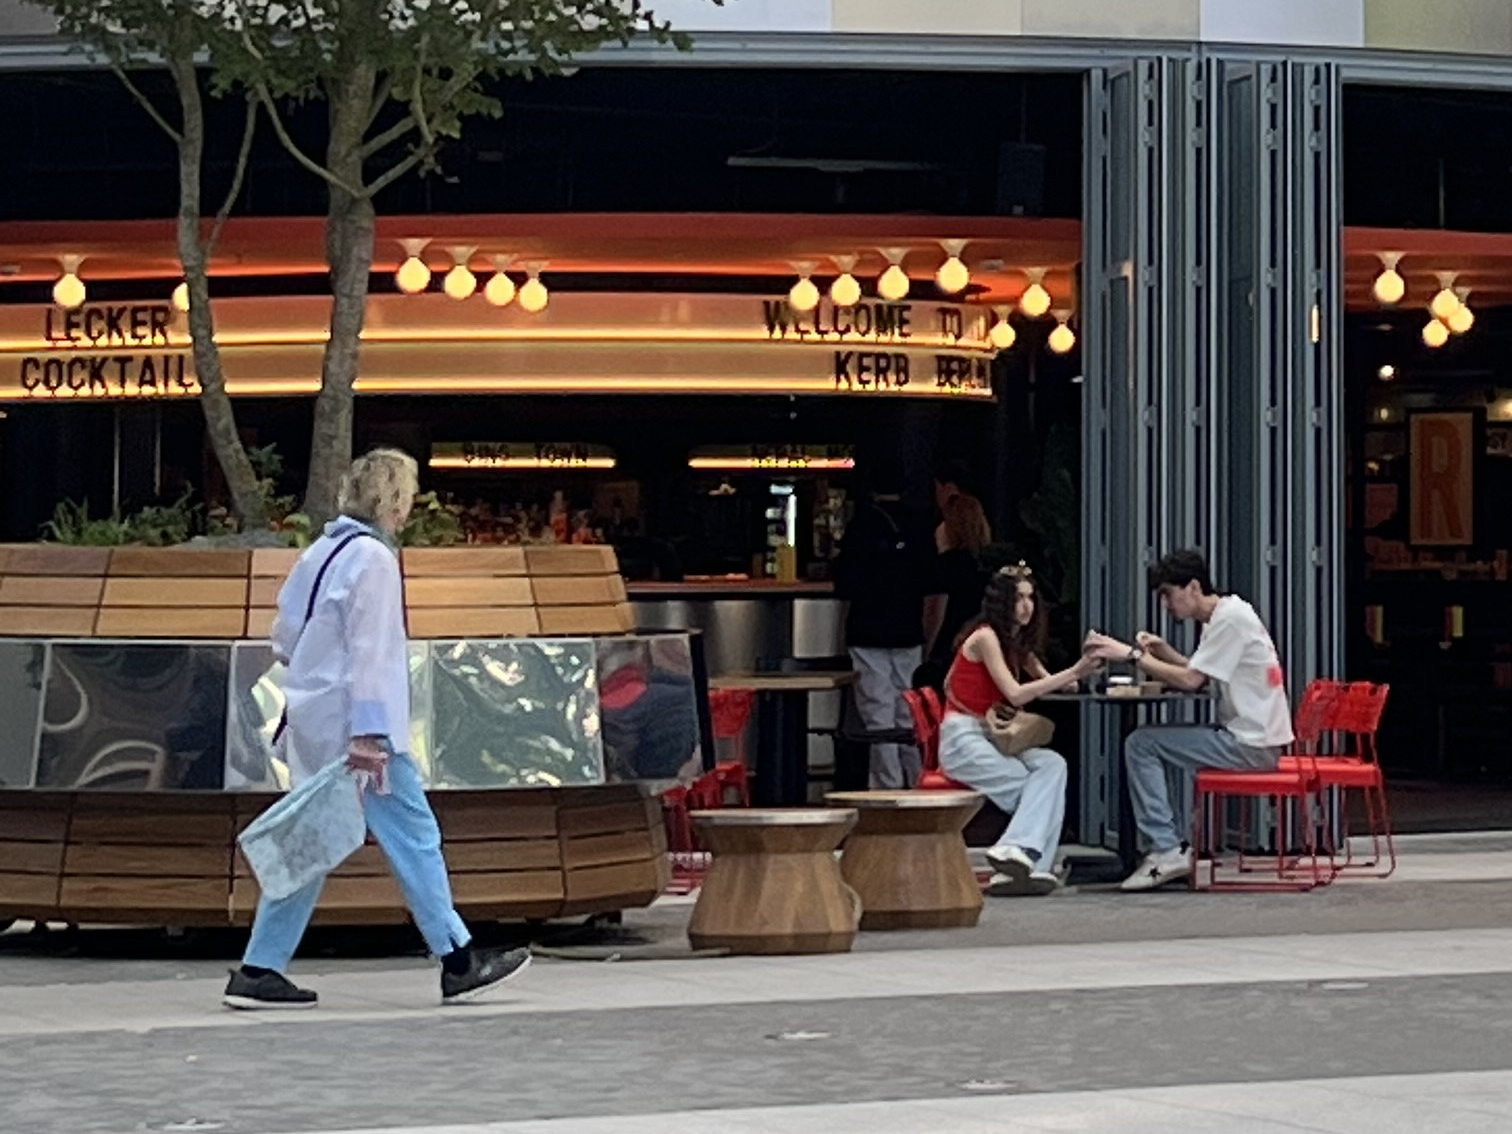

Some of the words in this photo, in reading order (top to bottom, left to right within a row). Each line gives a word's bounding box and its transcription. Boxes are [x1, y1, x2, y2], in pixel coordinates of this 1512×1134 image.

[45, 306, 171, 343] LECKER
[762, 299, 913, 337] WELCOME
[834, 350, 911, 387] KERB
